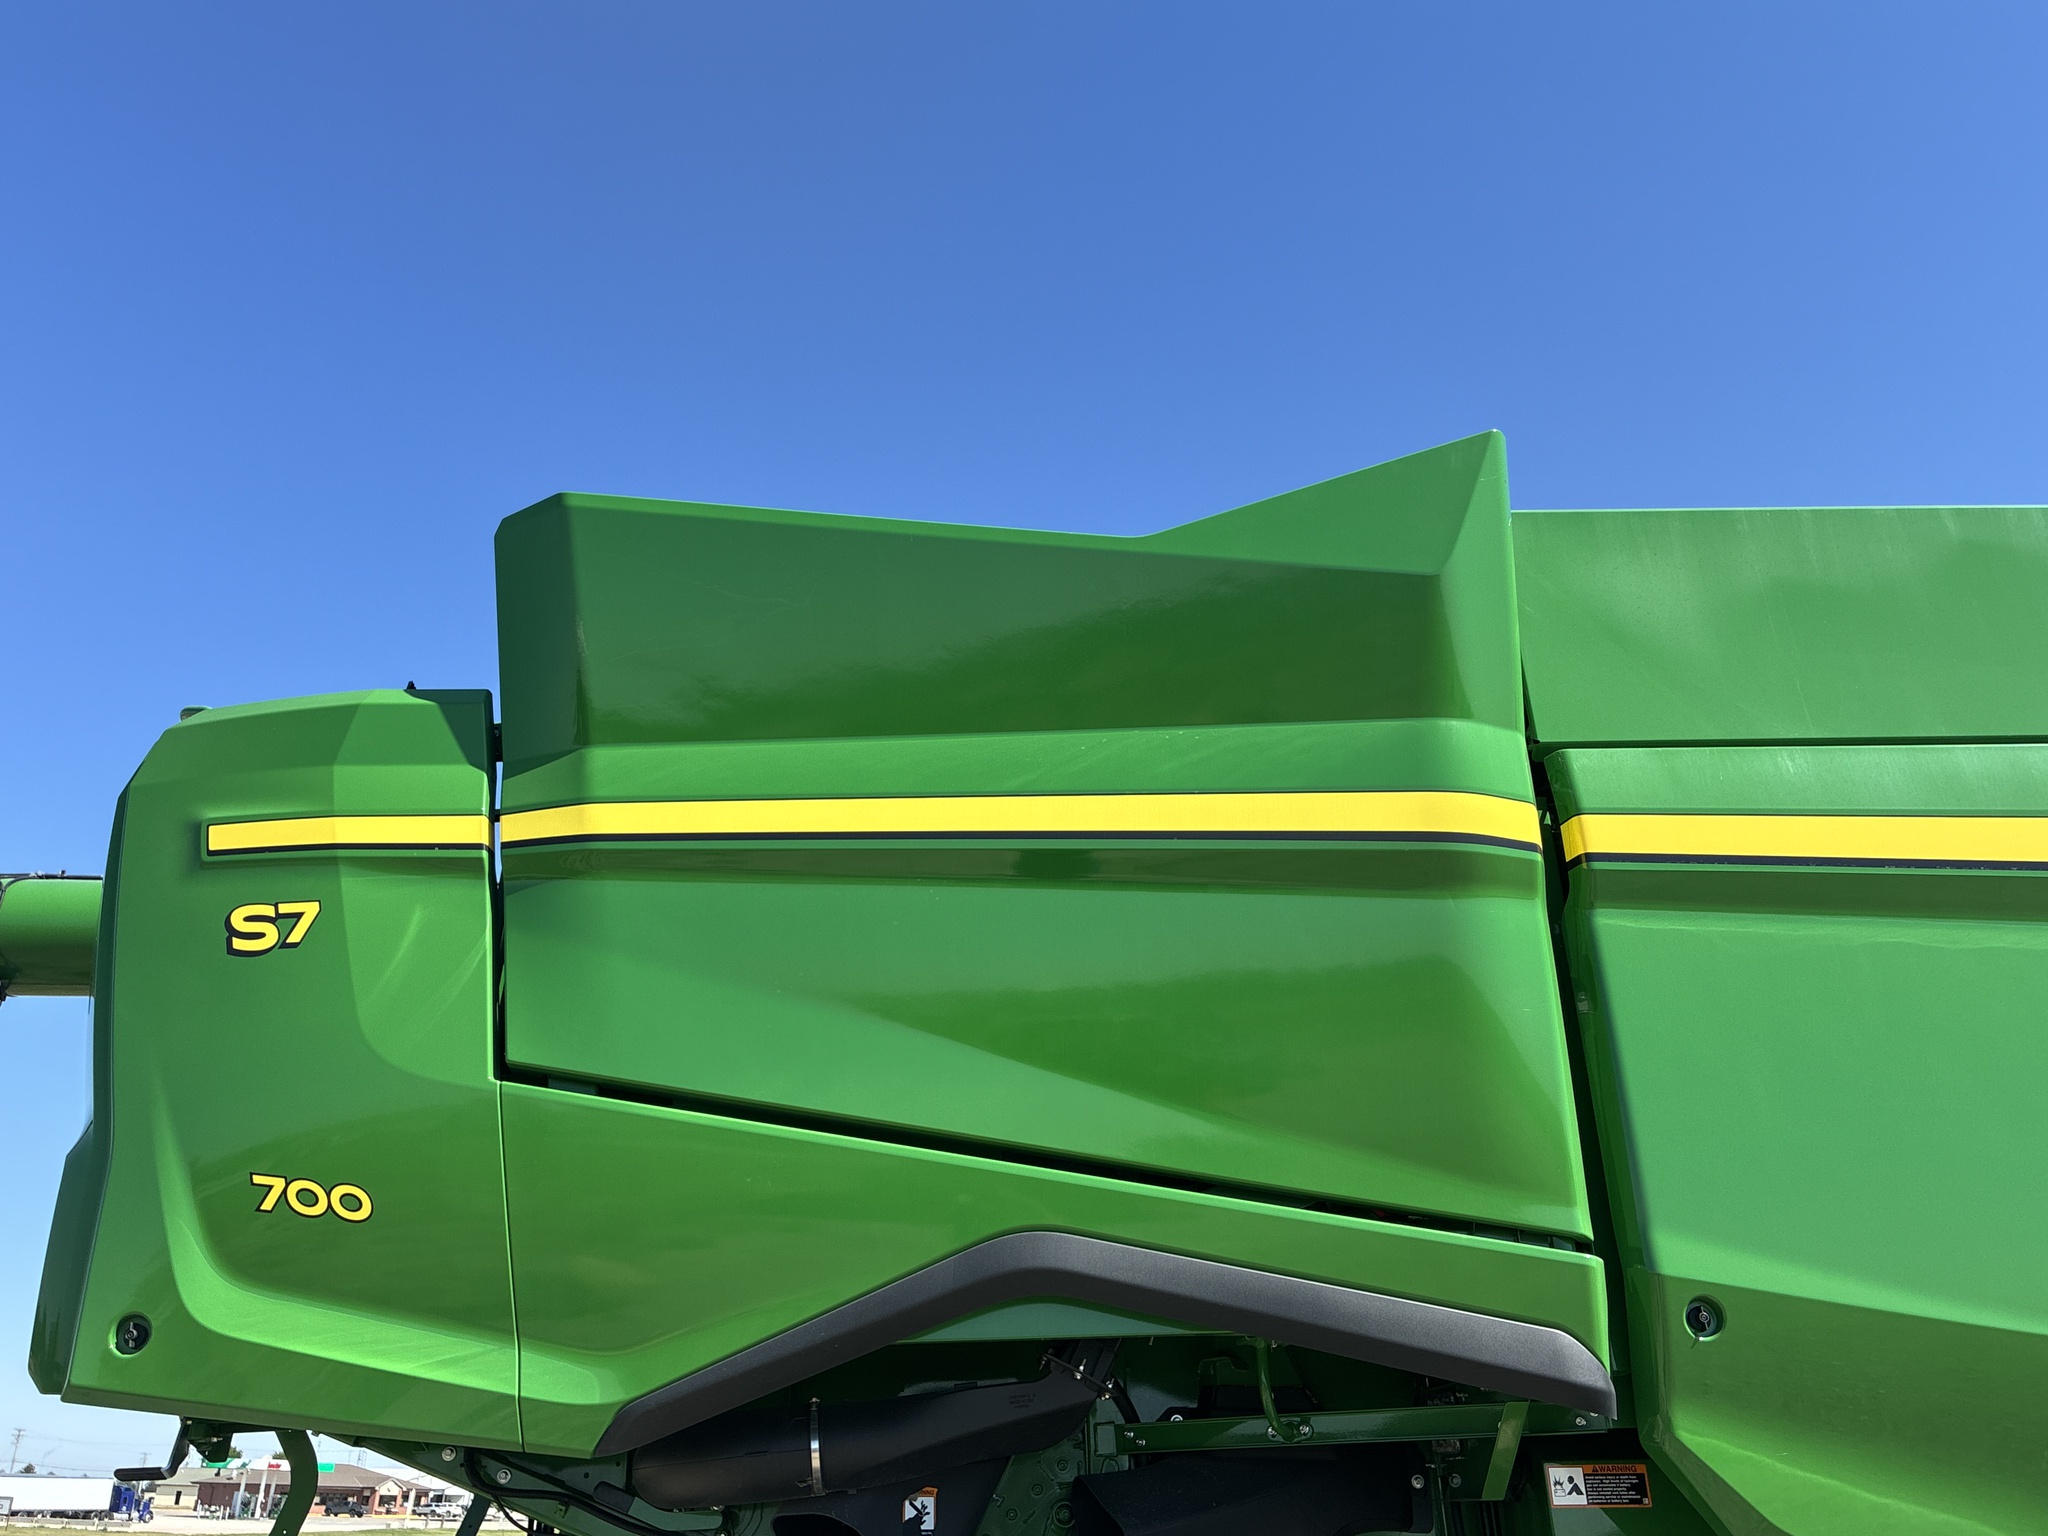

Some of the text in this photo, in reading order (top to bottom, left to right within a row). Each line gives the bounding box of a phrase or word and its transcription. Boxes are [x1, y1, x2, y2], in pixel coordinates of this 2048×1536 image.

[226, 900, 321, 957] S7
[250, 1172, 373, 1223] 700
[1599, 1465, 1637, 1473] WARNING
